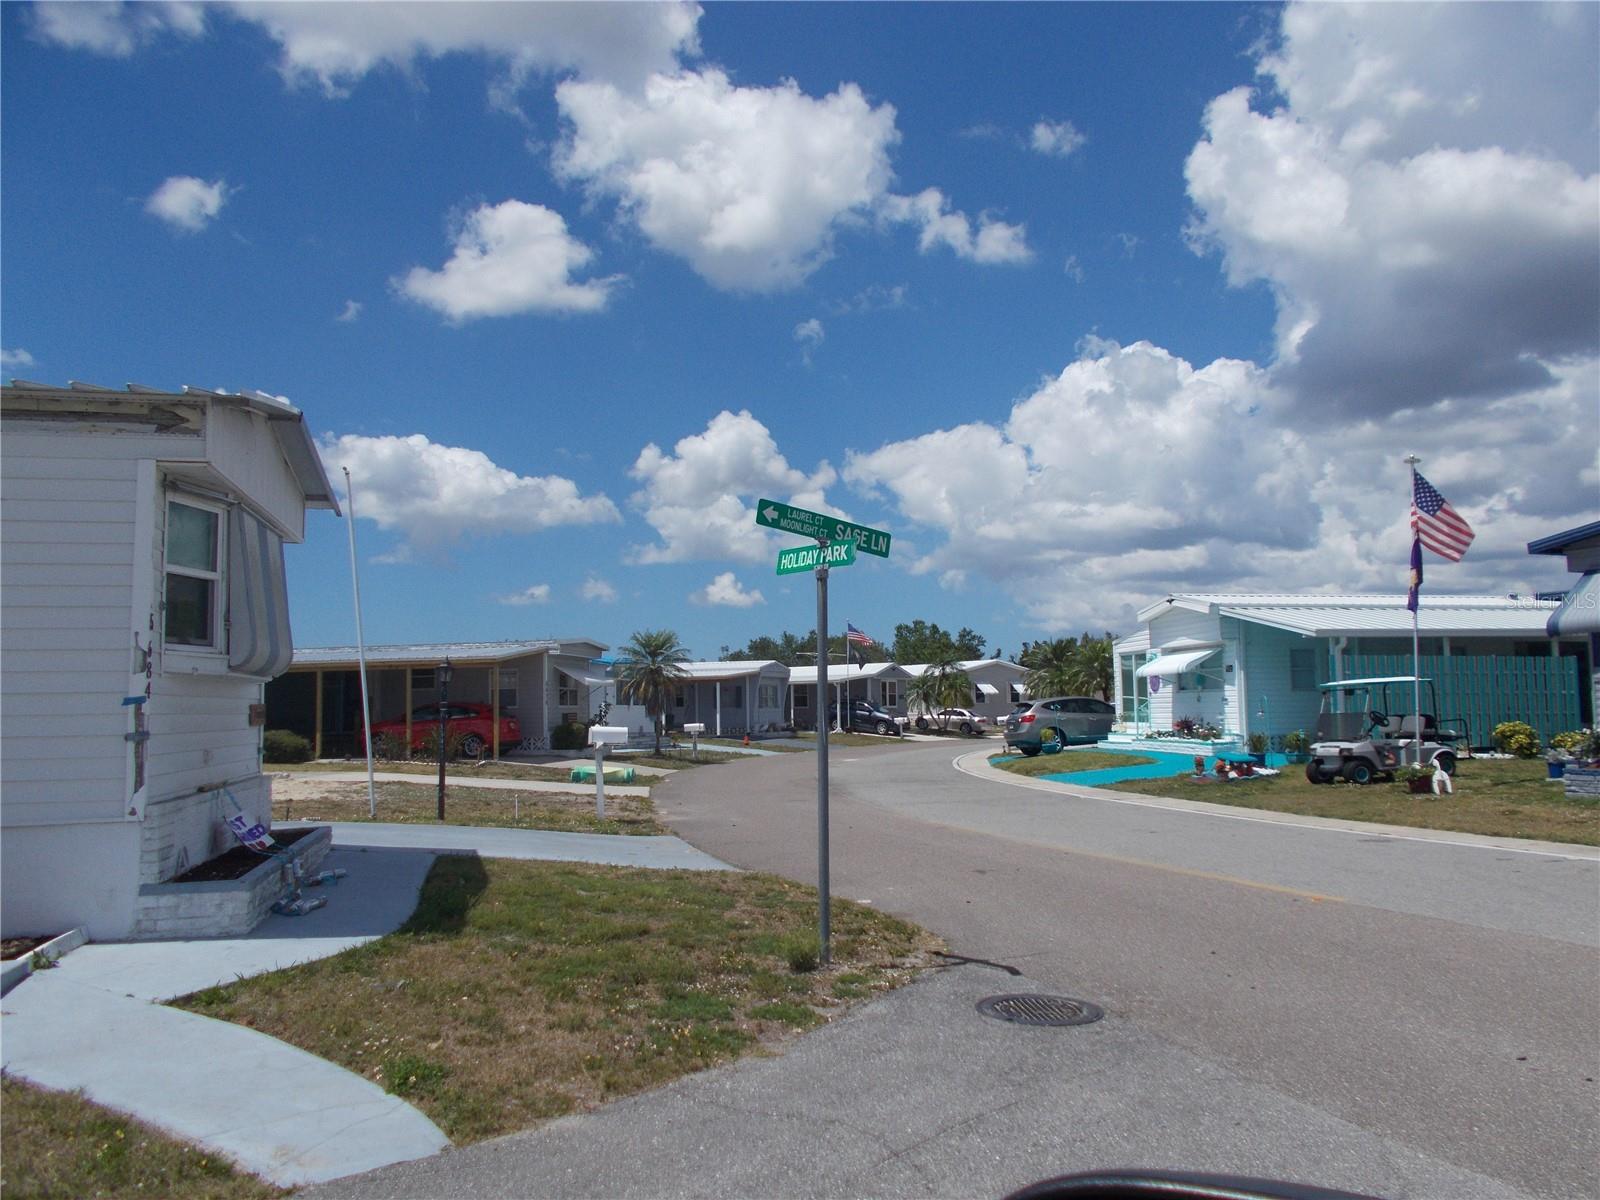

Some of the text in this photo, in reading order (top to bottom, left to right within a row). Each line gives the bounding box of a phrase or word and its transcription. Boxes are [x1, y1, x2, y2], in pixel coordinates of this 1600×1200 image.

[787, 509, 824, 525] LAUREL CT
[780, 519, 829, 537] MOONLIGHT CT
[835, 524, 869, 548] SAGE
[871, 534, 887, 552] LN
[780, 549, 819, 569] HOLIDAY
[820, 544, 848, 563] PARK
